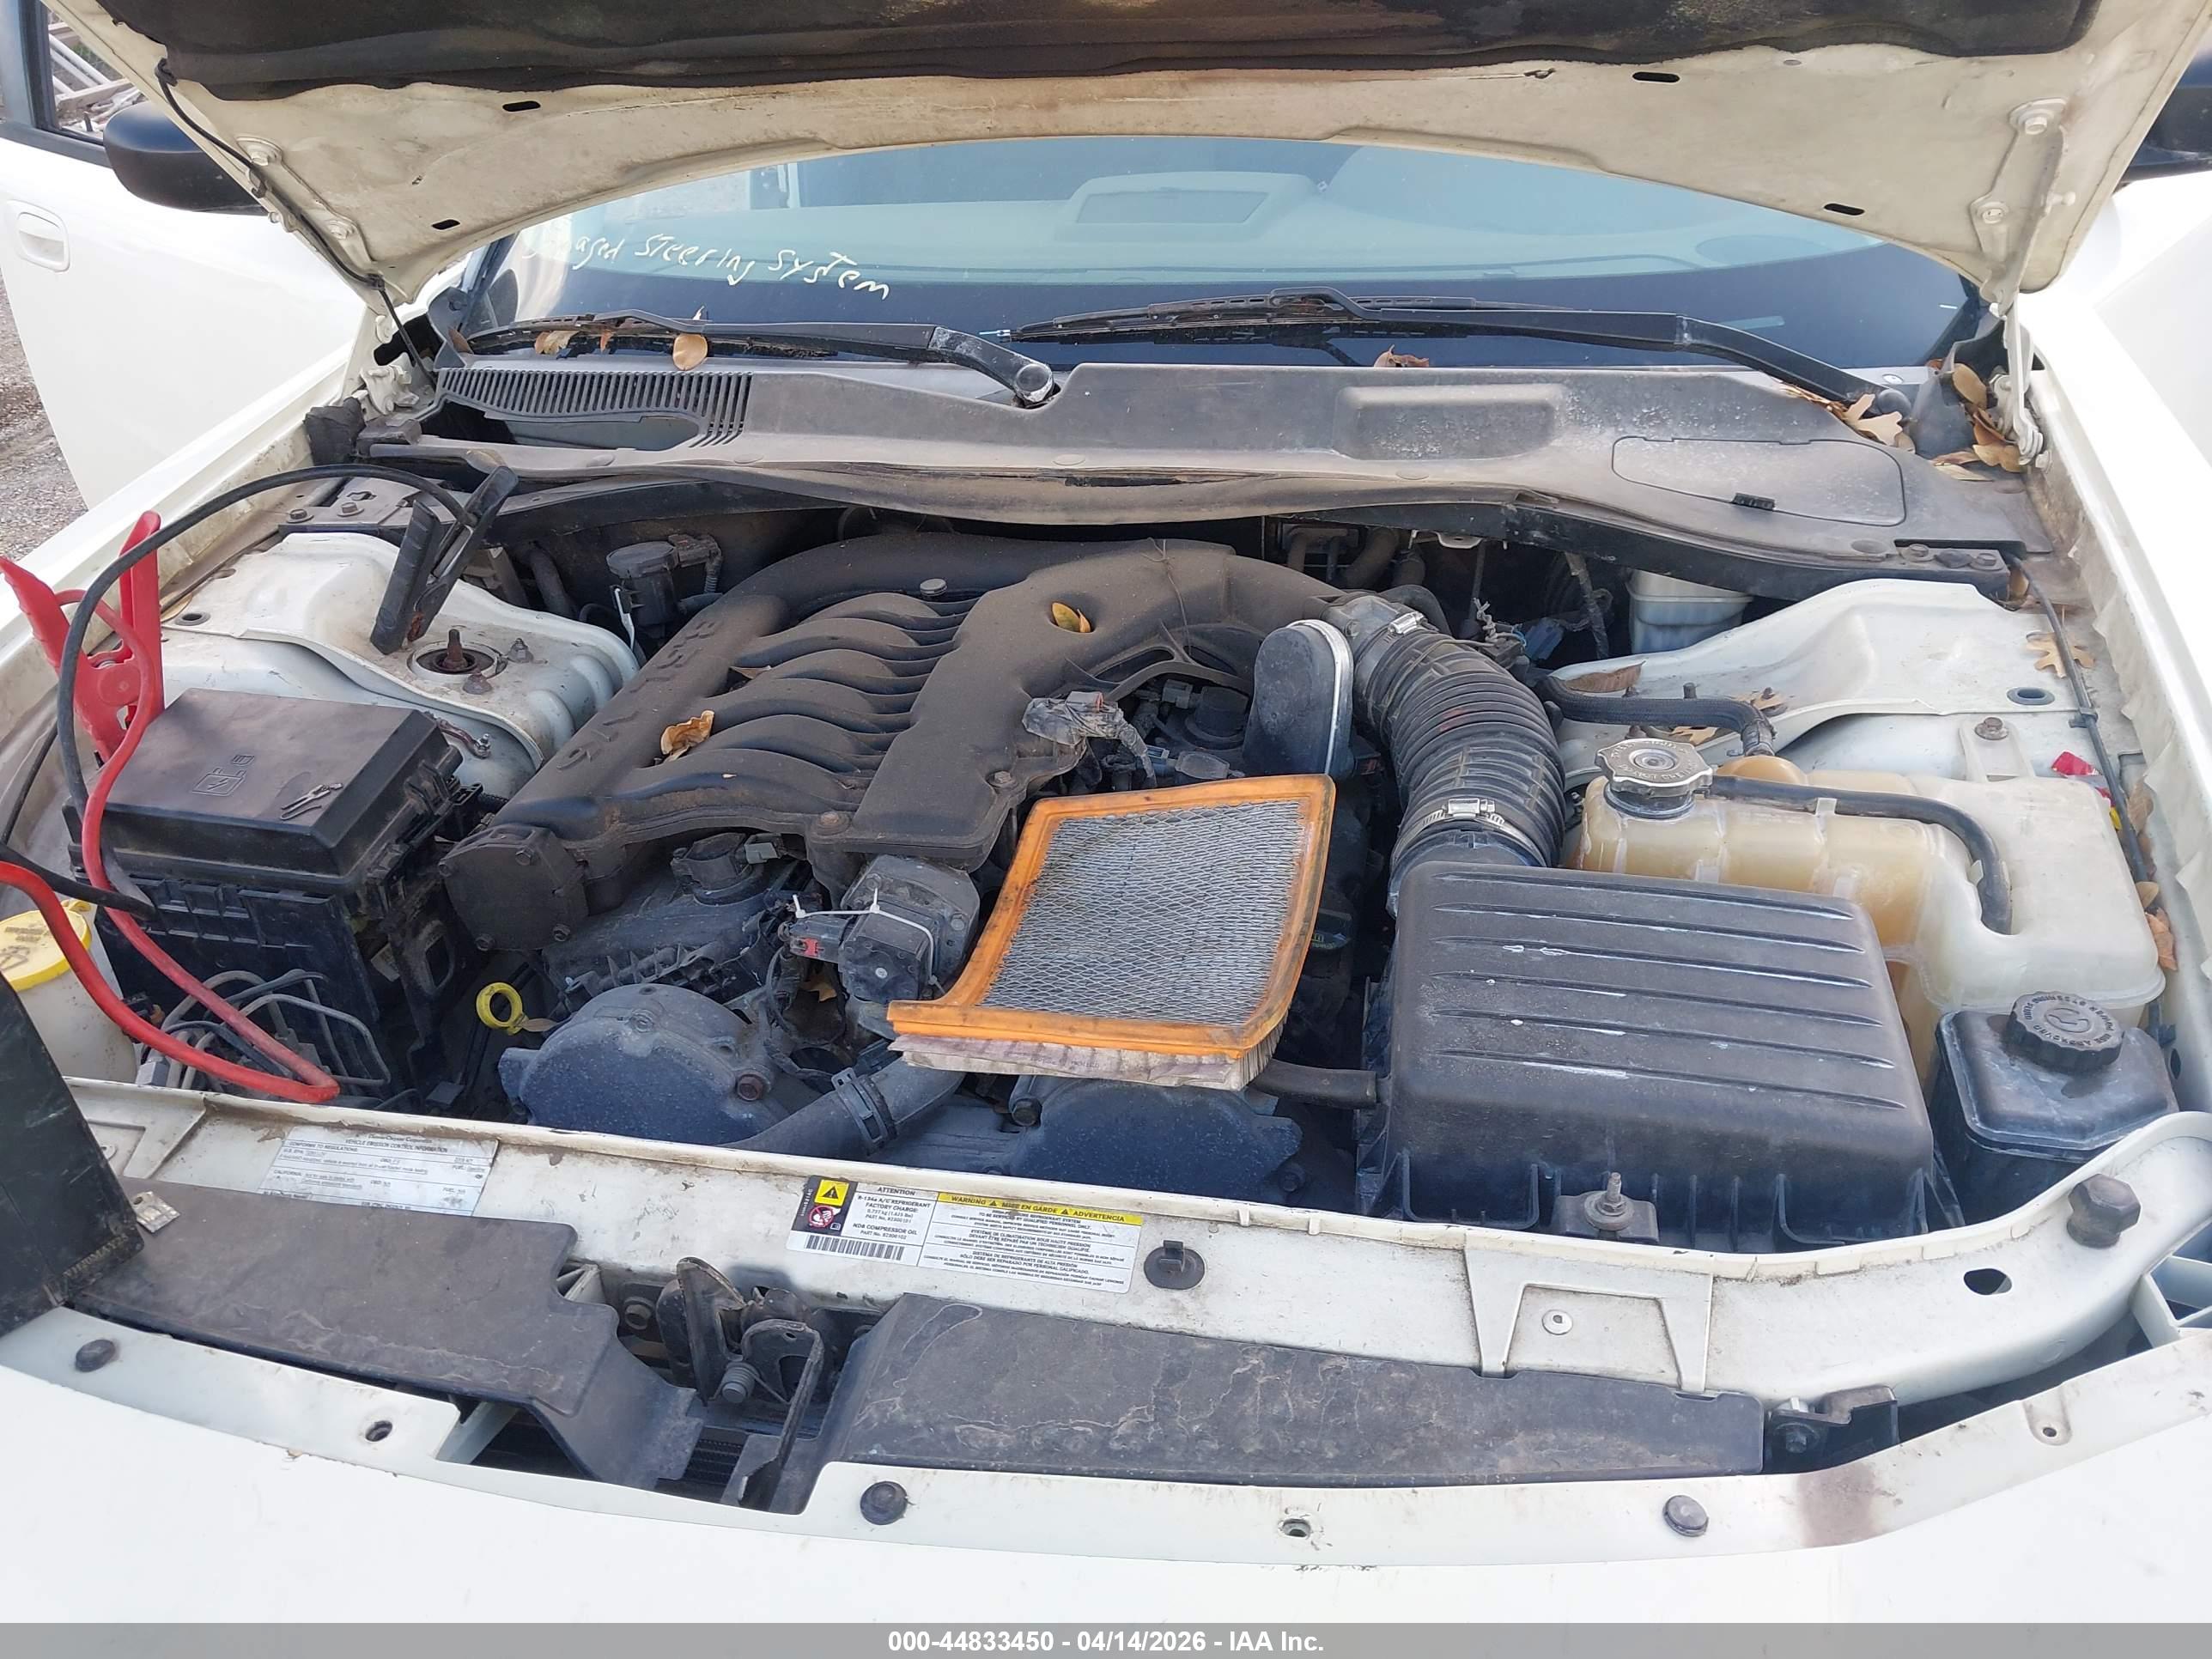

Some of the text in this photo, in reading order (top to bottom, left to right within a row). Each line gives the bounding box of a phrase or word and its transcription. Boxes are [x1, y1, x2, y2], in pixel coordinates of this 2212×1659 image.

[635, 234, 757, 286] Steering
[877, 1187, 915, 1195] ATTENTION
[890, 1199, 930, 1208] REFRIGERANT
[951, 1195, 987, 1205] WARNING
[1032, 1205, 1058, 1213] GARDE
[866, 1224, 907, 1233] COMPRESSOR
